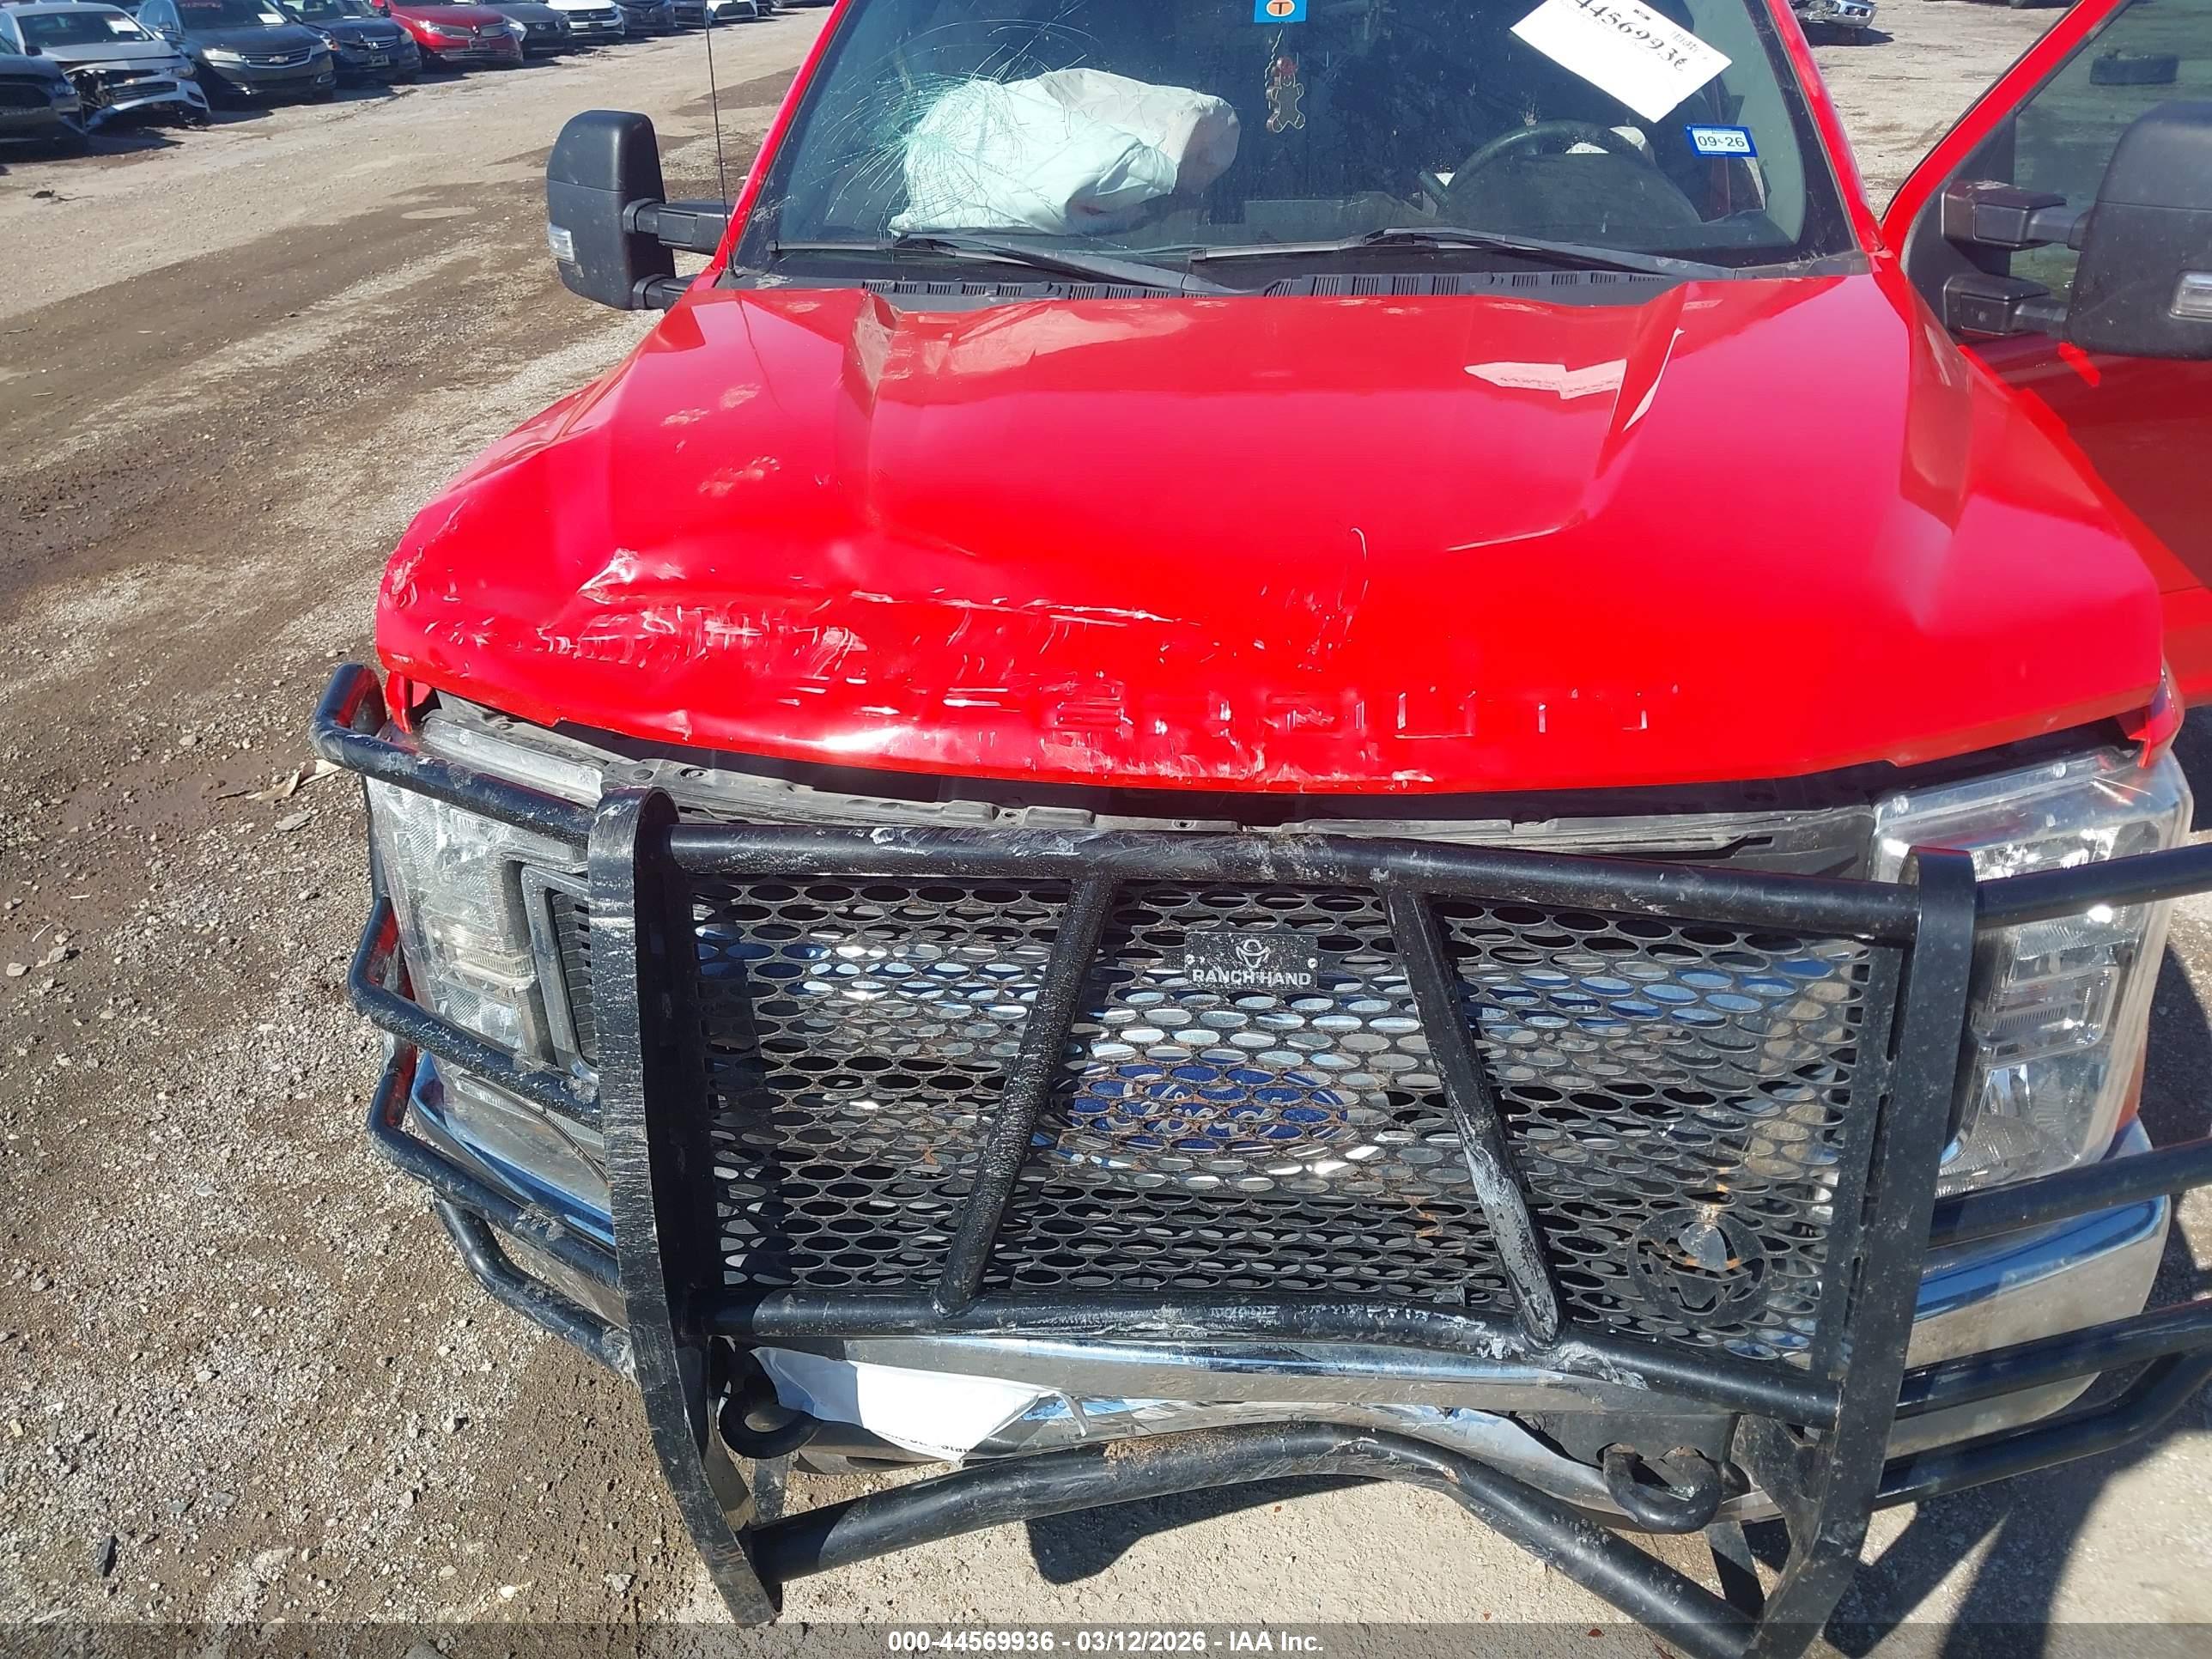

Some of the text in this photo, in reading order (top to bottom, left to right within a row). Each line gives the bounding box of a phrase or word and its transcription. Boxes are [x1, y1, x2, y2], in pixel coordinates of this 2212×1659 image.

[1698, 136, 1745, 148] 09 26
[1192, 969, 1311, 988] RANCH HAND
